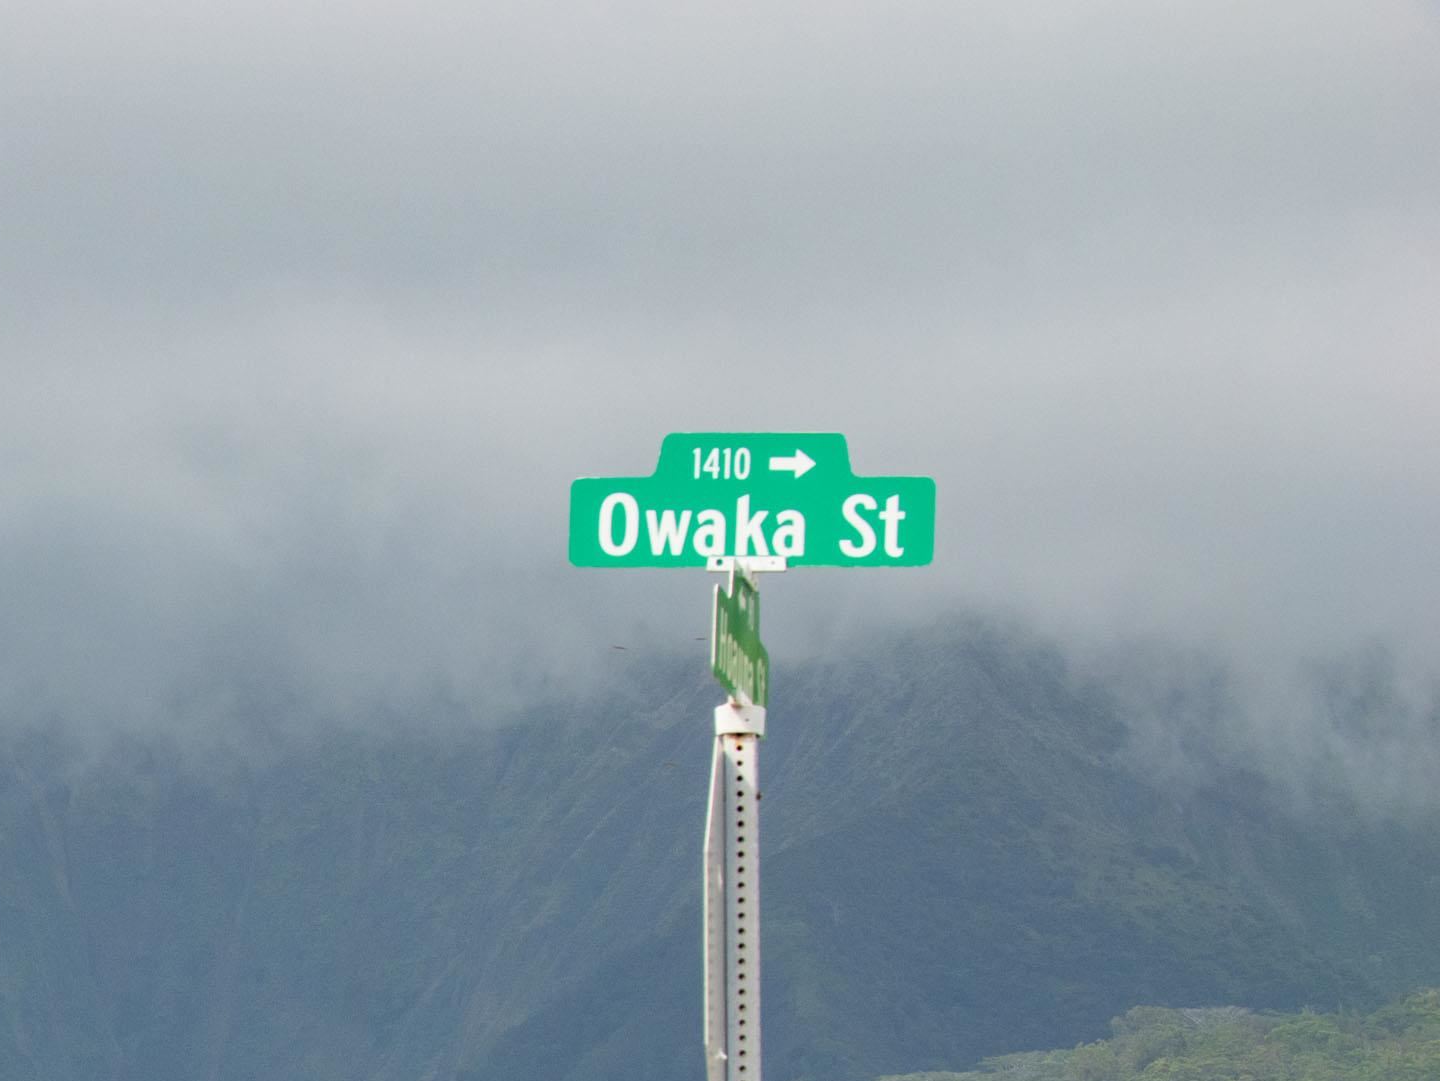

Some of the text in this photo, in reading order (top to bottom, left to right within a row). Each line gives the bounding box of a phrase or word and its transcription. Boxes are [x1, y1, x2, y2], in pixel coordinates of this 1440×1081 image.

[692, 447, 752, 481] 1410
[598, 492, 907, 558] Owaka St
